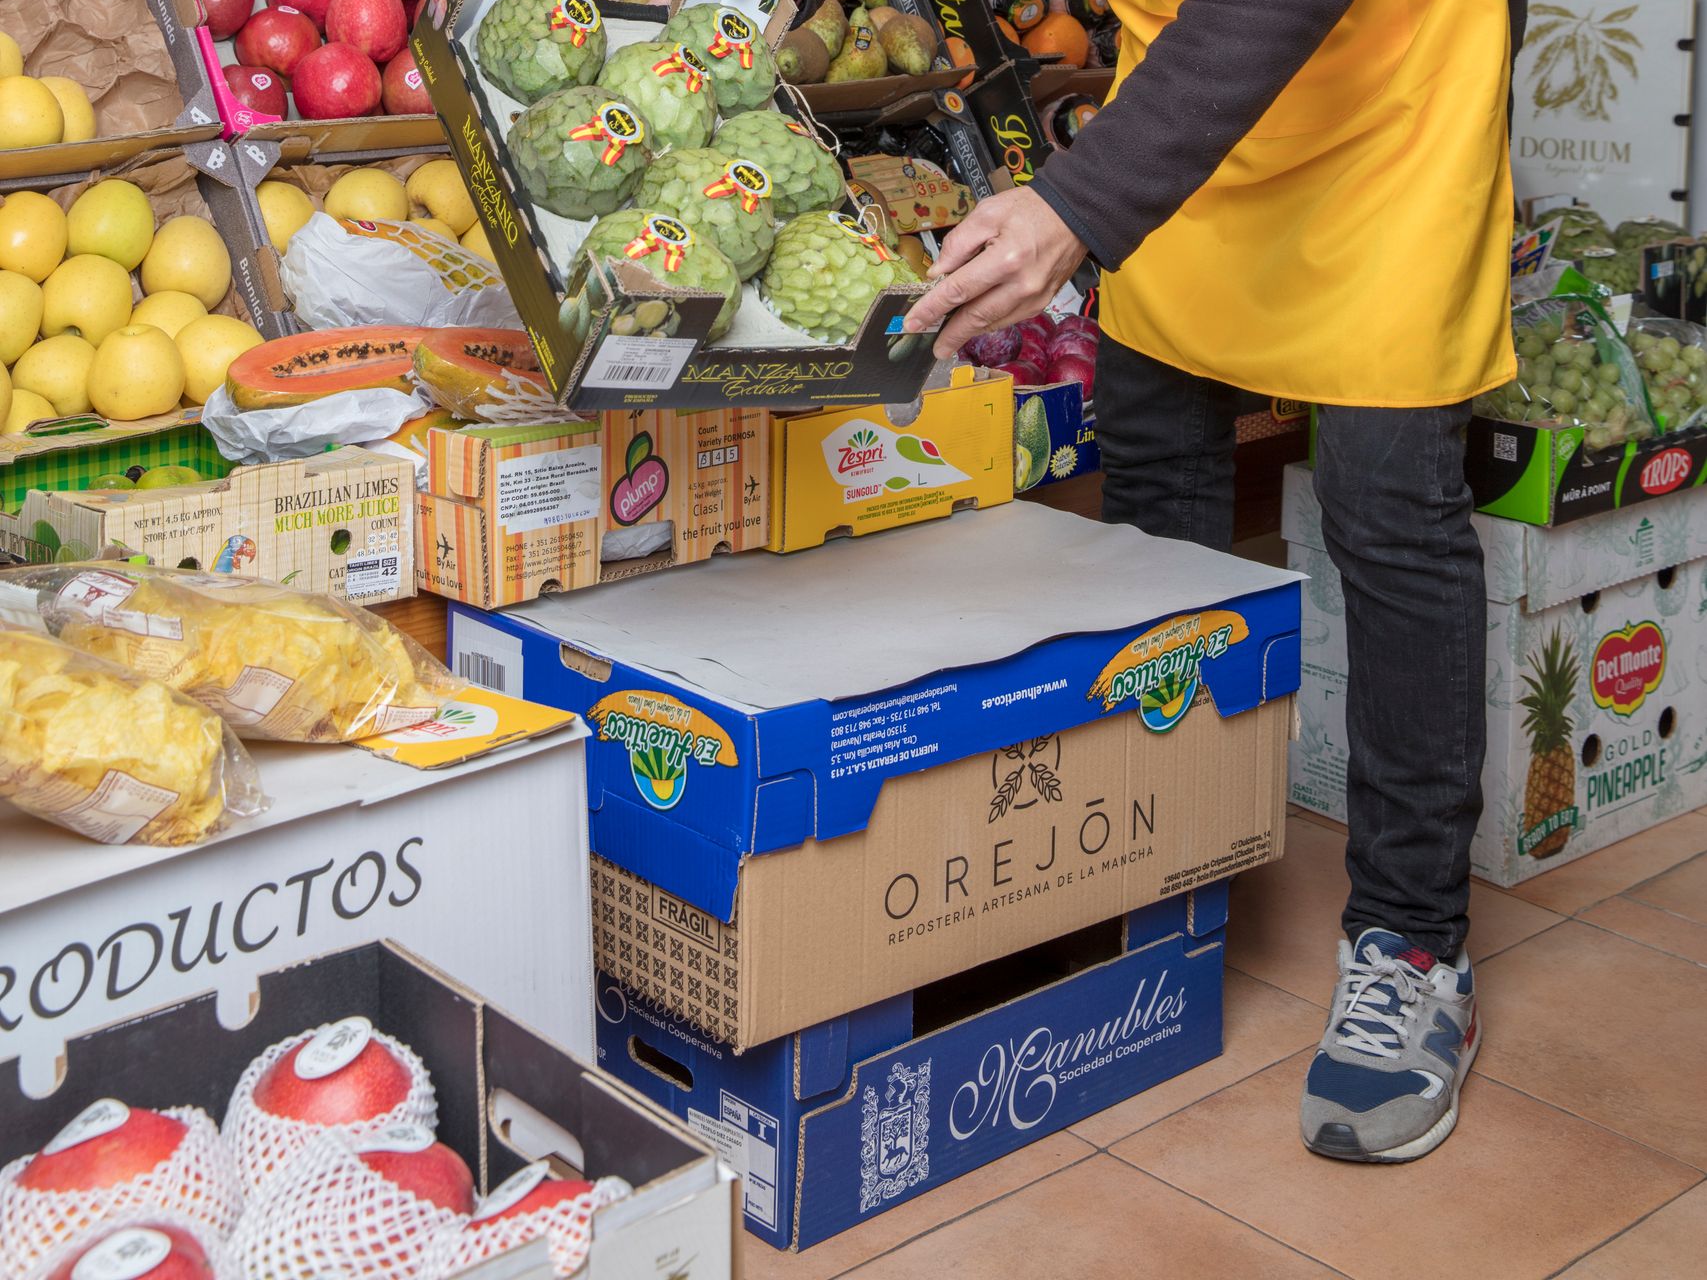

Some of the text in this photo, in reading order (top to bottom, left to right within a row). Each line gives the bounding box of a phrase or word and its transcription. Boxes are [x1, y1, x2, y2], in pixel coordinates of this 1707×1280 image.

[954, 129, 983, 185] PERAS DE
[1519, 136, 1632, 163] DORIUM
[463, 114, 519, 249] MANZANO
[239, 257, 264, 329] Brunilda
[682, 361, 854, 381] MANZANO
[698, 425, 718, 435] Count
[698, 430, 756, 448] Variety FORMOSA
[1076, 427, 1096, 445] Lin
[729, 449, 736, 460] 5
[838, 443, 885, 474] Zespri
[850, 467, 874, 477] KIWIFRUIT
[1642, 452, 1690, 488] TROPS
[500, 487, 523, 496] Country
[531, 483, 549, 493] origin:
[549, 479, 565, 487] Brazil
[707, 478, 728, 488] approx.
[1588, 481, 1612, 497] POINT
[275, 477, 399, 514] BRAZILIAN LIMES
[500, 493, 529, 504] ZIP CODE:
[620, 473, 659, 518] plump
[694, 488, 722, 500] Net Weight
[743, 494, 761, 505] By Air
[134, 518, 149, 529] NET
[165, 514, 179, 525] 4.5
[191, 507, 224, 520] APPROX.
[274, 496, 400, 534] MUCH MORE JUICE
[693, 503, 718, 517] Class
[371, 517, 398, 531] COUNT
[683, 515, 761, 541] the fruit you love
[143, 529, 178, 543] STORE AT
[368, 531, 398, 543] 32 42
[506, 543, 528, 553] PHONE
[536, 537, 548, 547] 351
[357, 549, 365, 557] 48
[383, 558, 396, 567] SIZE
[506, 549, 540, 563] Fax: 351
[381, 566, 398, 577] 42
[436, 557, 456, 571] By Air
[506, 561, 577, 582] fruits@plumpfruits.com
[431, 572, 463, 591] you love
[1108, 635, 1206, 703] Huertico
[1597, 645, 1662, 683] Del Monte
[981, 678, 1068, 710] www.elhuertico.es
[1614, 675, 1644, 695] Quality
[832, 683, 958, 722] huertadeperalta@huertadeperalta.com
[830, 701, 941, 738] Tel. 948 713 735 948 713 803
[603, 711, 721, 768] El Huertico
[831, 723, 907, 752] 31350 Peralta (Navarra)
[884, 738, 901, 750] Arlas
[901, 734, 918, 746] Ctra.
[1605, 729, 1652, 762] GOLD
[843, 749, 856, 761] Km.
[856, 743, 884, 758] Marcilla
[830, 742, 939, 780] HUERTA DE PERALTA S.A.T. 413
[1587, 748, 1666, 811] PINEAPPLE
[1263, 830, 1271, 839] 14
[1548, 817, 1558, 834] TO
[1181, 846, 1256, 878] Campo de Criptana (Ciudad
[888, 845, 1154, 946] REPOSTERÍA ARTESANA DE LA MANCHA
[658, 895, 715, 942] FRÁGIL
[628, 999, 667, 1032] Sociedad
[667, 1023, 723, 1061] Cooperativa
[949, 969, 1187, 1141] Manubles
[1058, 1023, 1182, 1085] Sociedad Cooperativa
[723, 1104, 742, 1122] ESPAÑA
